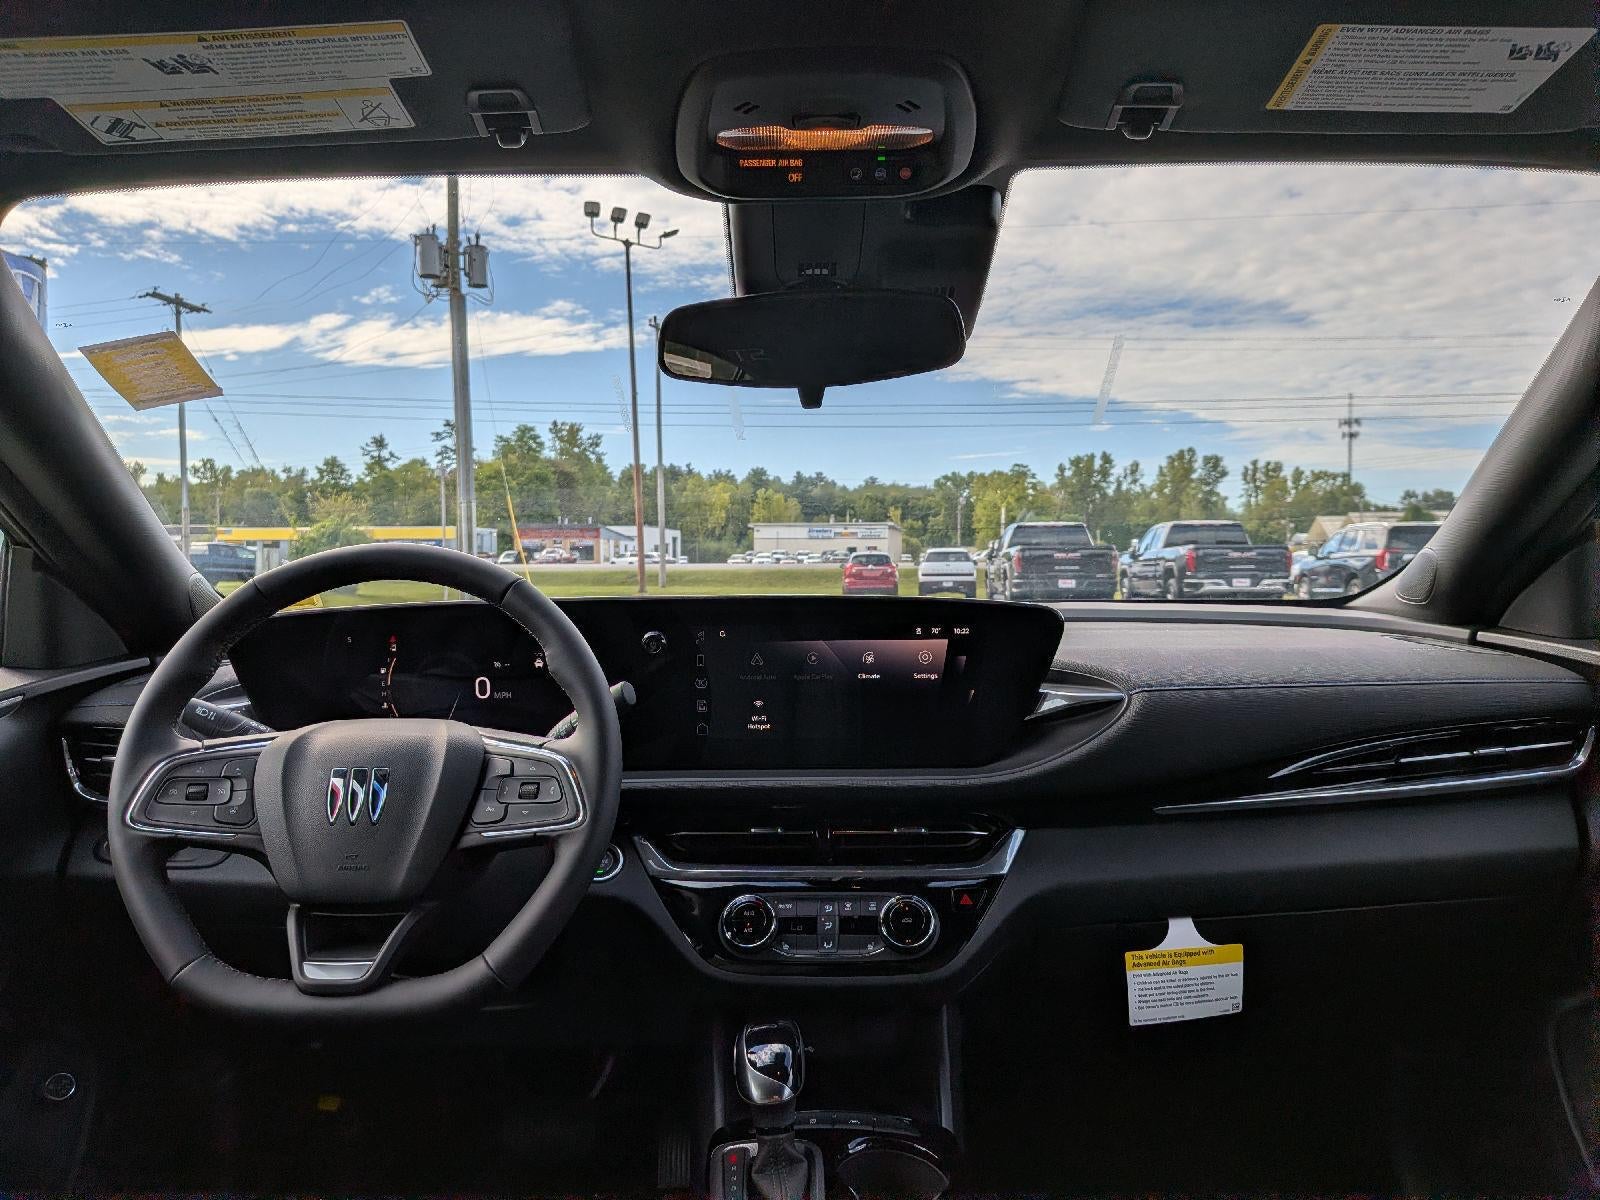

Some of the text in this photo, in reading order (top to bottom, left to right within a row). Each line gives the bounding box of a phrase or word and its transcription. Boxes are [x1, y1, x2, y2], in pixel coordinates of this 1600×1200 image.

[1391, 27, 1444, 35] ADVANCED
[211, 31, 297, 42] AVERTISSEMENT
[739, 159, 803, 167] PASSENGER AIR BAG
[788, 173, 803, 183] OFF
[913, 672, 938, 680] Settings
[475, 676, 491, 699] 0
[493, 691, 512, 699] MPH
[1131, 948, 1215, 961] This Vehicle is Equipped with
[1131, 958, 1187, 968] Advanced Air Bags
